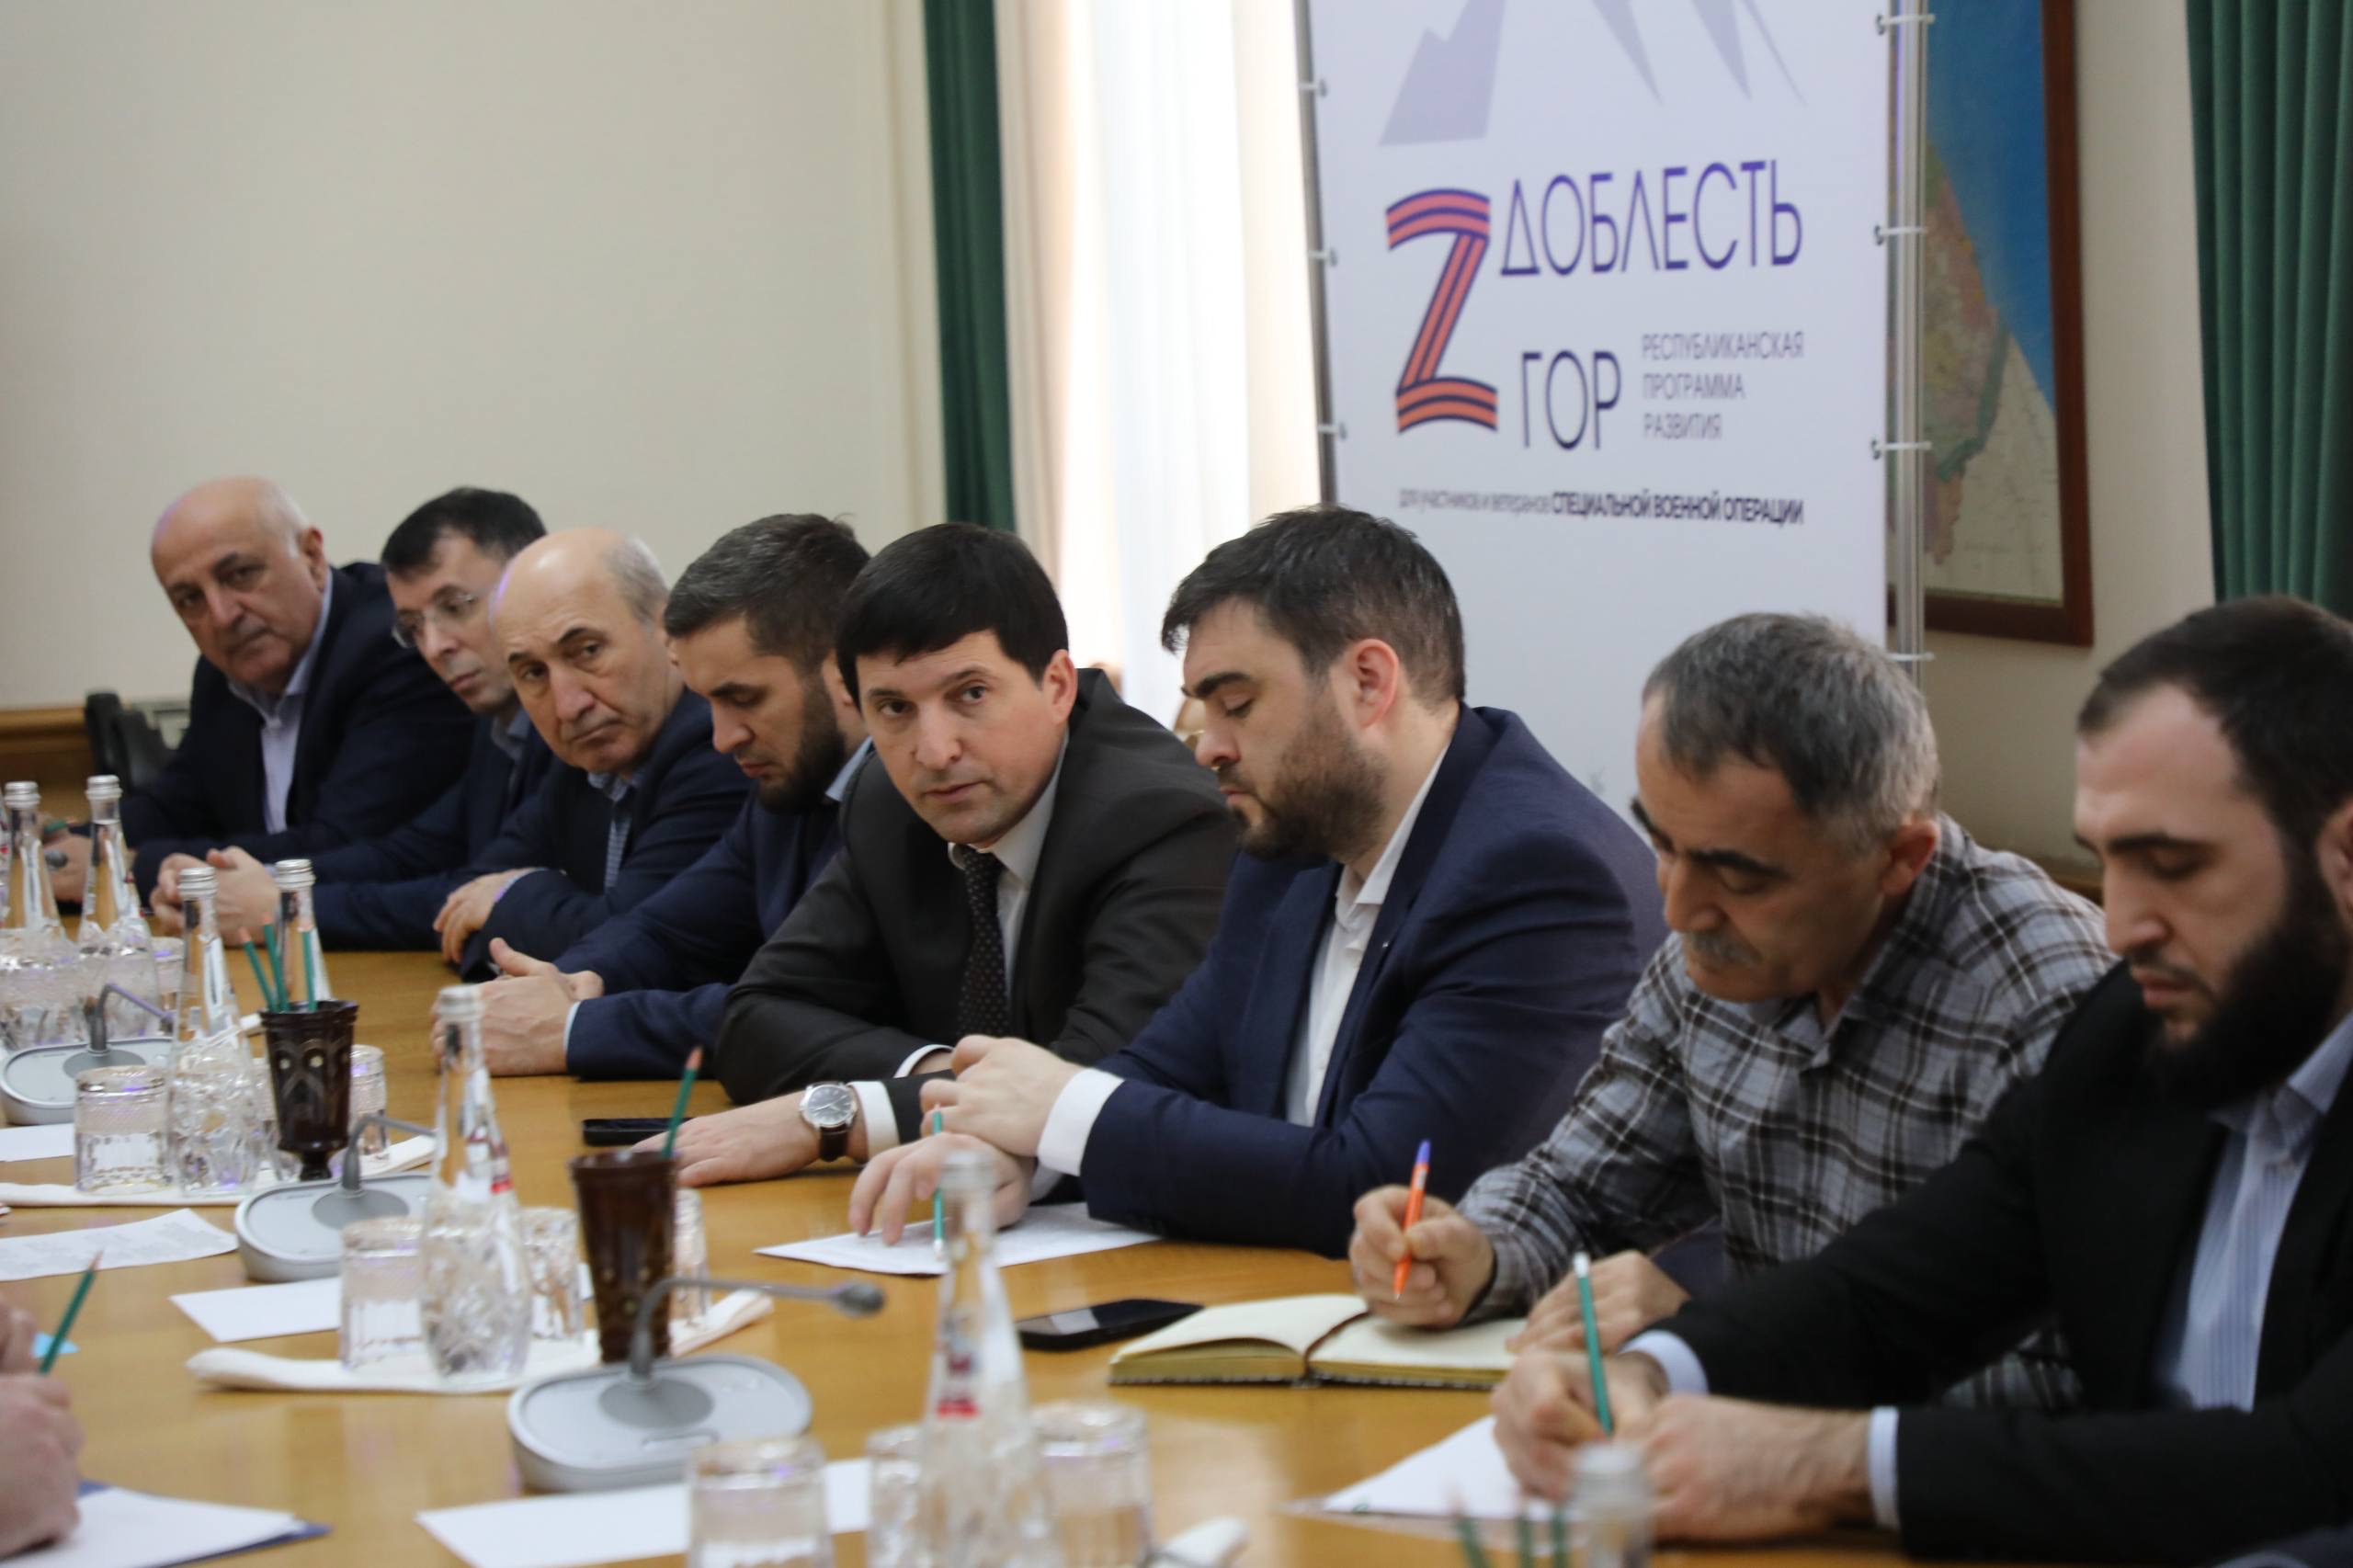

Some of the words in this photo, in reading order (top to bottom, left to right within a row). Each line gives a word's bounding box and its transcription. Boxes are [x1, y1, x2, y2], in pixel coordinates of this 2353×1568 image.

[1500, 159, 1802, 276] ДОБЛЕСТЬ
[1642, 330, 1805, 360] РЕСПУБЛИКАНСКАЯ
[1521, 349, 1621, 450] ГОР
[1643, 372, 1746, 400] ПРОГРАММА
[1643, 413, 1723, 440] РАЗВИТИЯ
[1552, 487, 1651, 520] СПЕЦИАЛЬНОЙ
[1654, 489, 1721, 520] ВОЕННОЙ
[1722, 495, 1804, 529] ОПЕРАЦИИ
